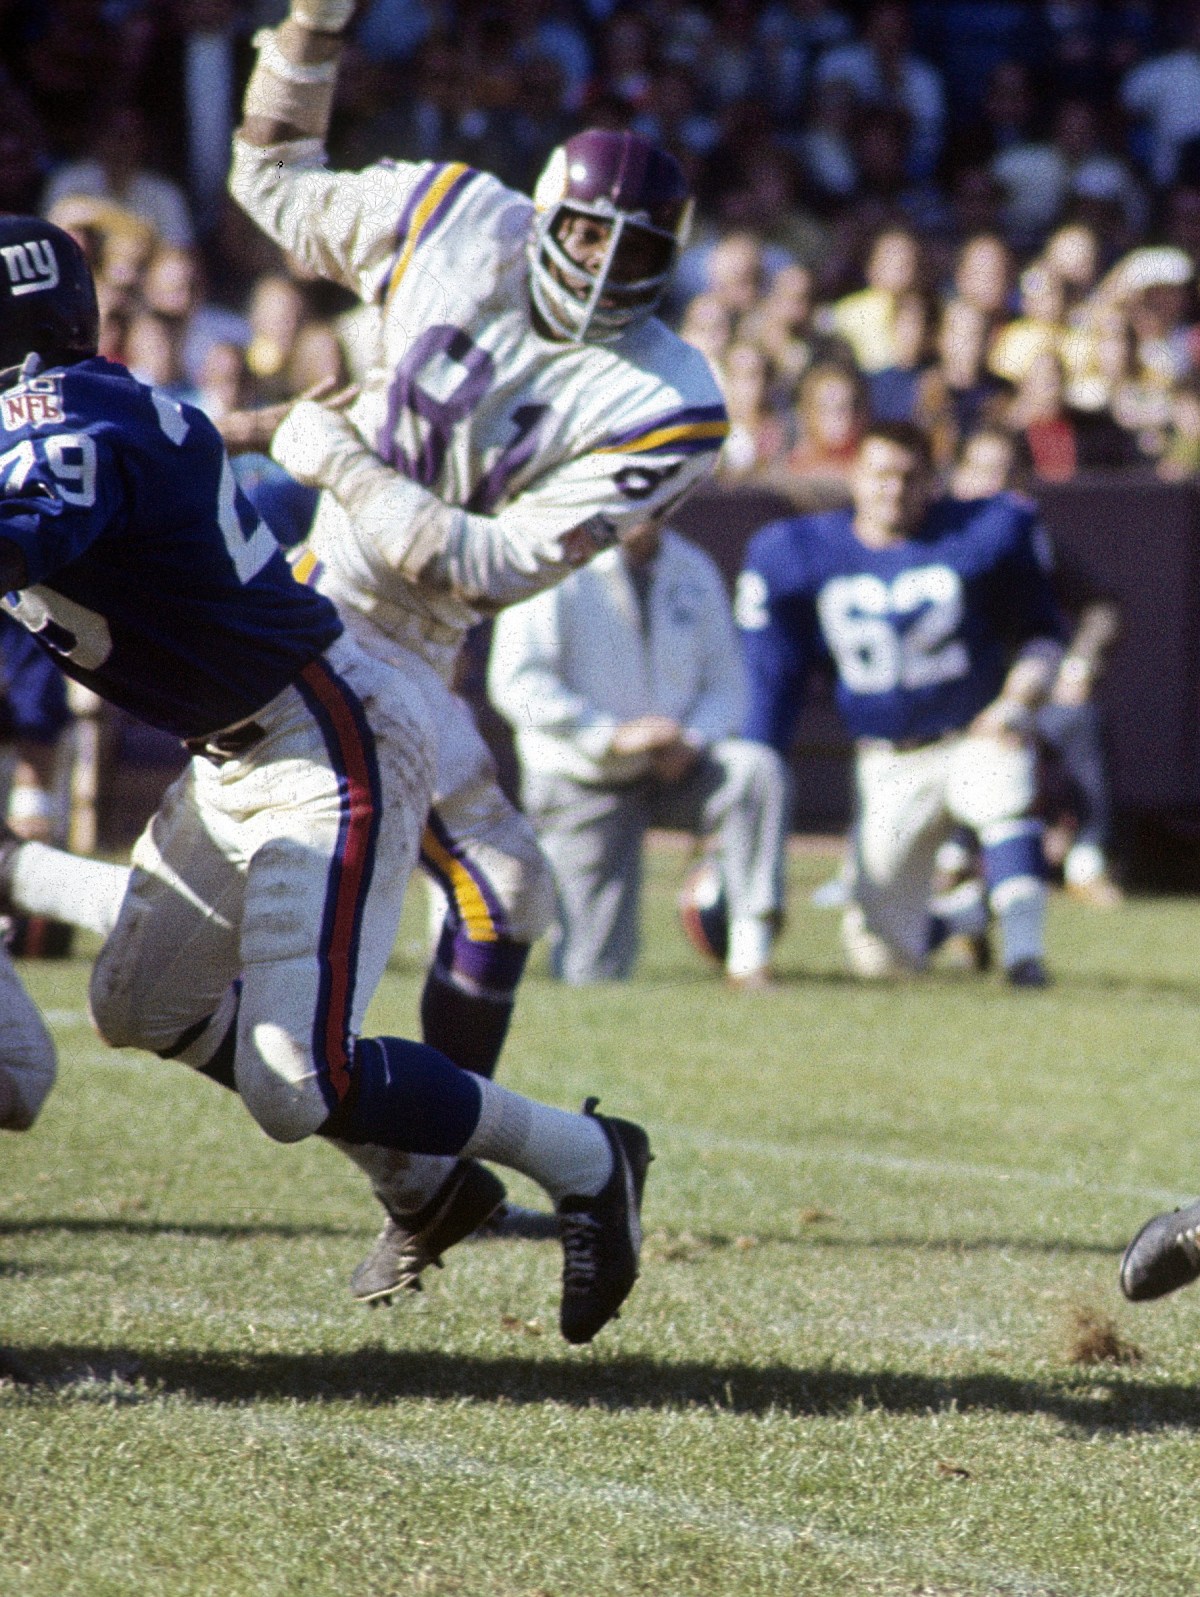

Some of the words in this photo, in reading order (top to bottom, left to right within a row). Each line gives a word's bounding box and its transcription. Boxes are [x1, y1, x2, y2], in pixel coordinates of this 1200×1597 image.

[6, 395, 60, 424] NFL
[0, 433, 98, 508] 79
[816, 563, 971, 695] 62
